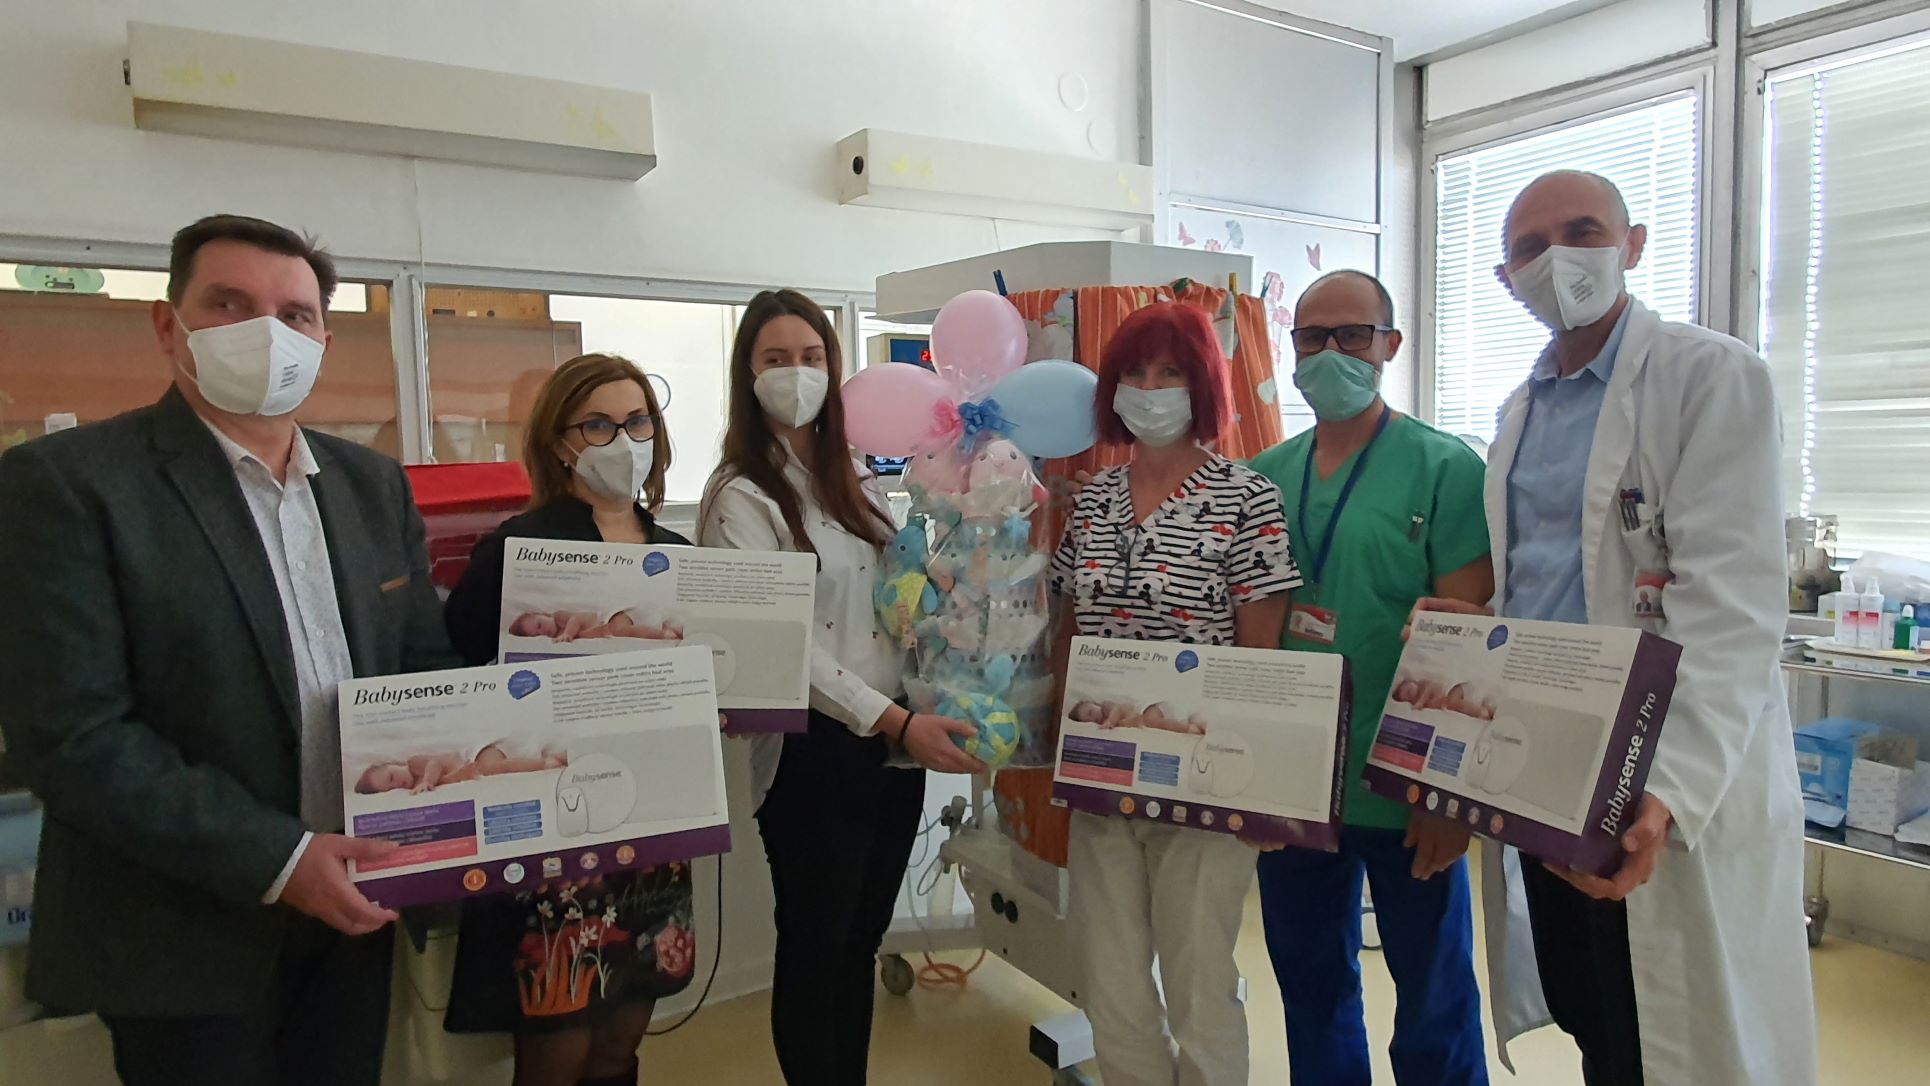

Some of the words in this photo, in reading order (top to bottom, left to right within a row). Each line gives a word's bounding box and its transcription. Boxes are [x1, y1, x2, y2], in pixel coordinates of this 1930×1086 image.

[516, 547, 599, 566] Babysense
[602, 554, 611, 564] 2
[614, 554, 634, 566] Pro
[1078, 643, 1140, 661] Babysense
[354, 683, 454, 706] Babysense
[459, 682, 469, 694] 2
[473, 680, 497, 693] Pro
[1639, 692, 1657, 720] Pro
[1635, 719, 1648, 733] 2
[1600, 734, 1644, 837] Babysense
